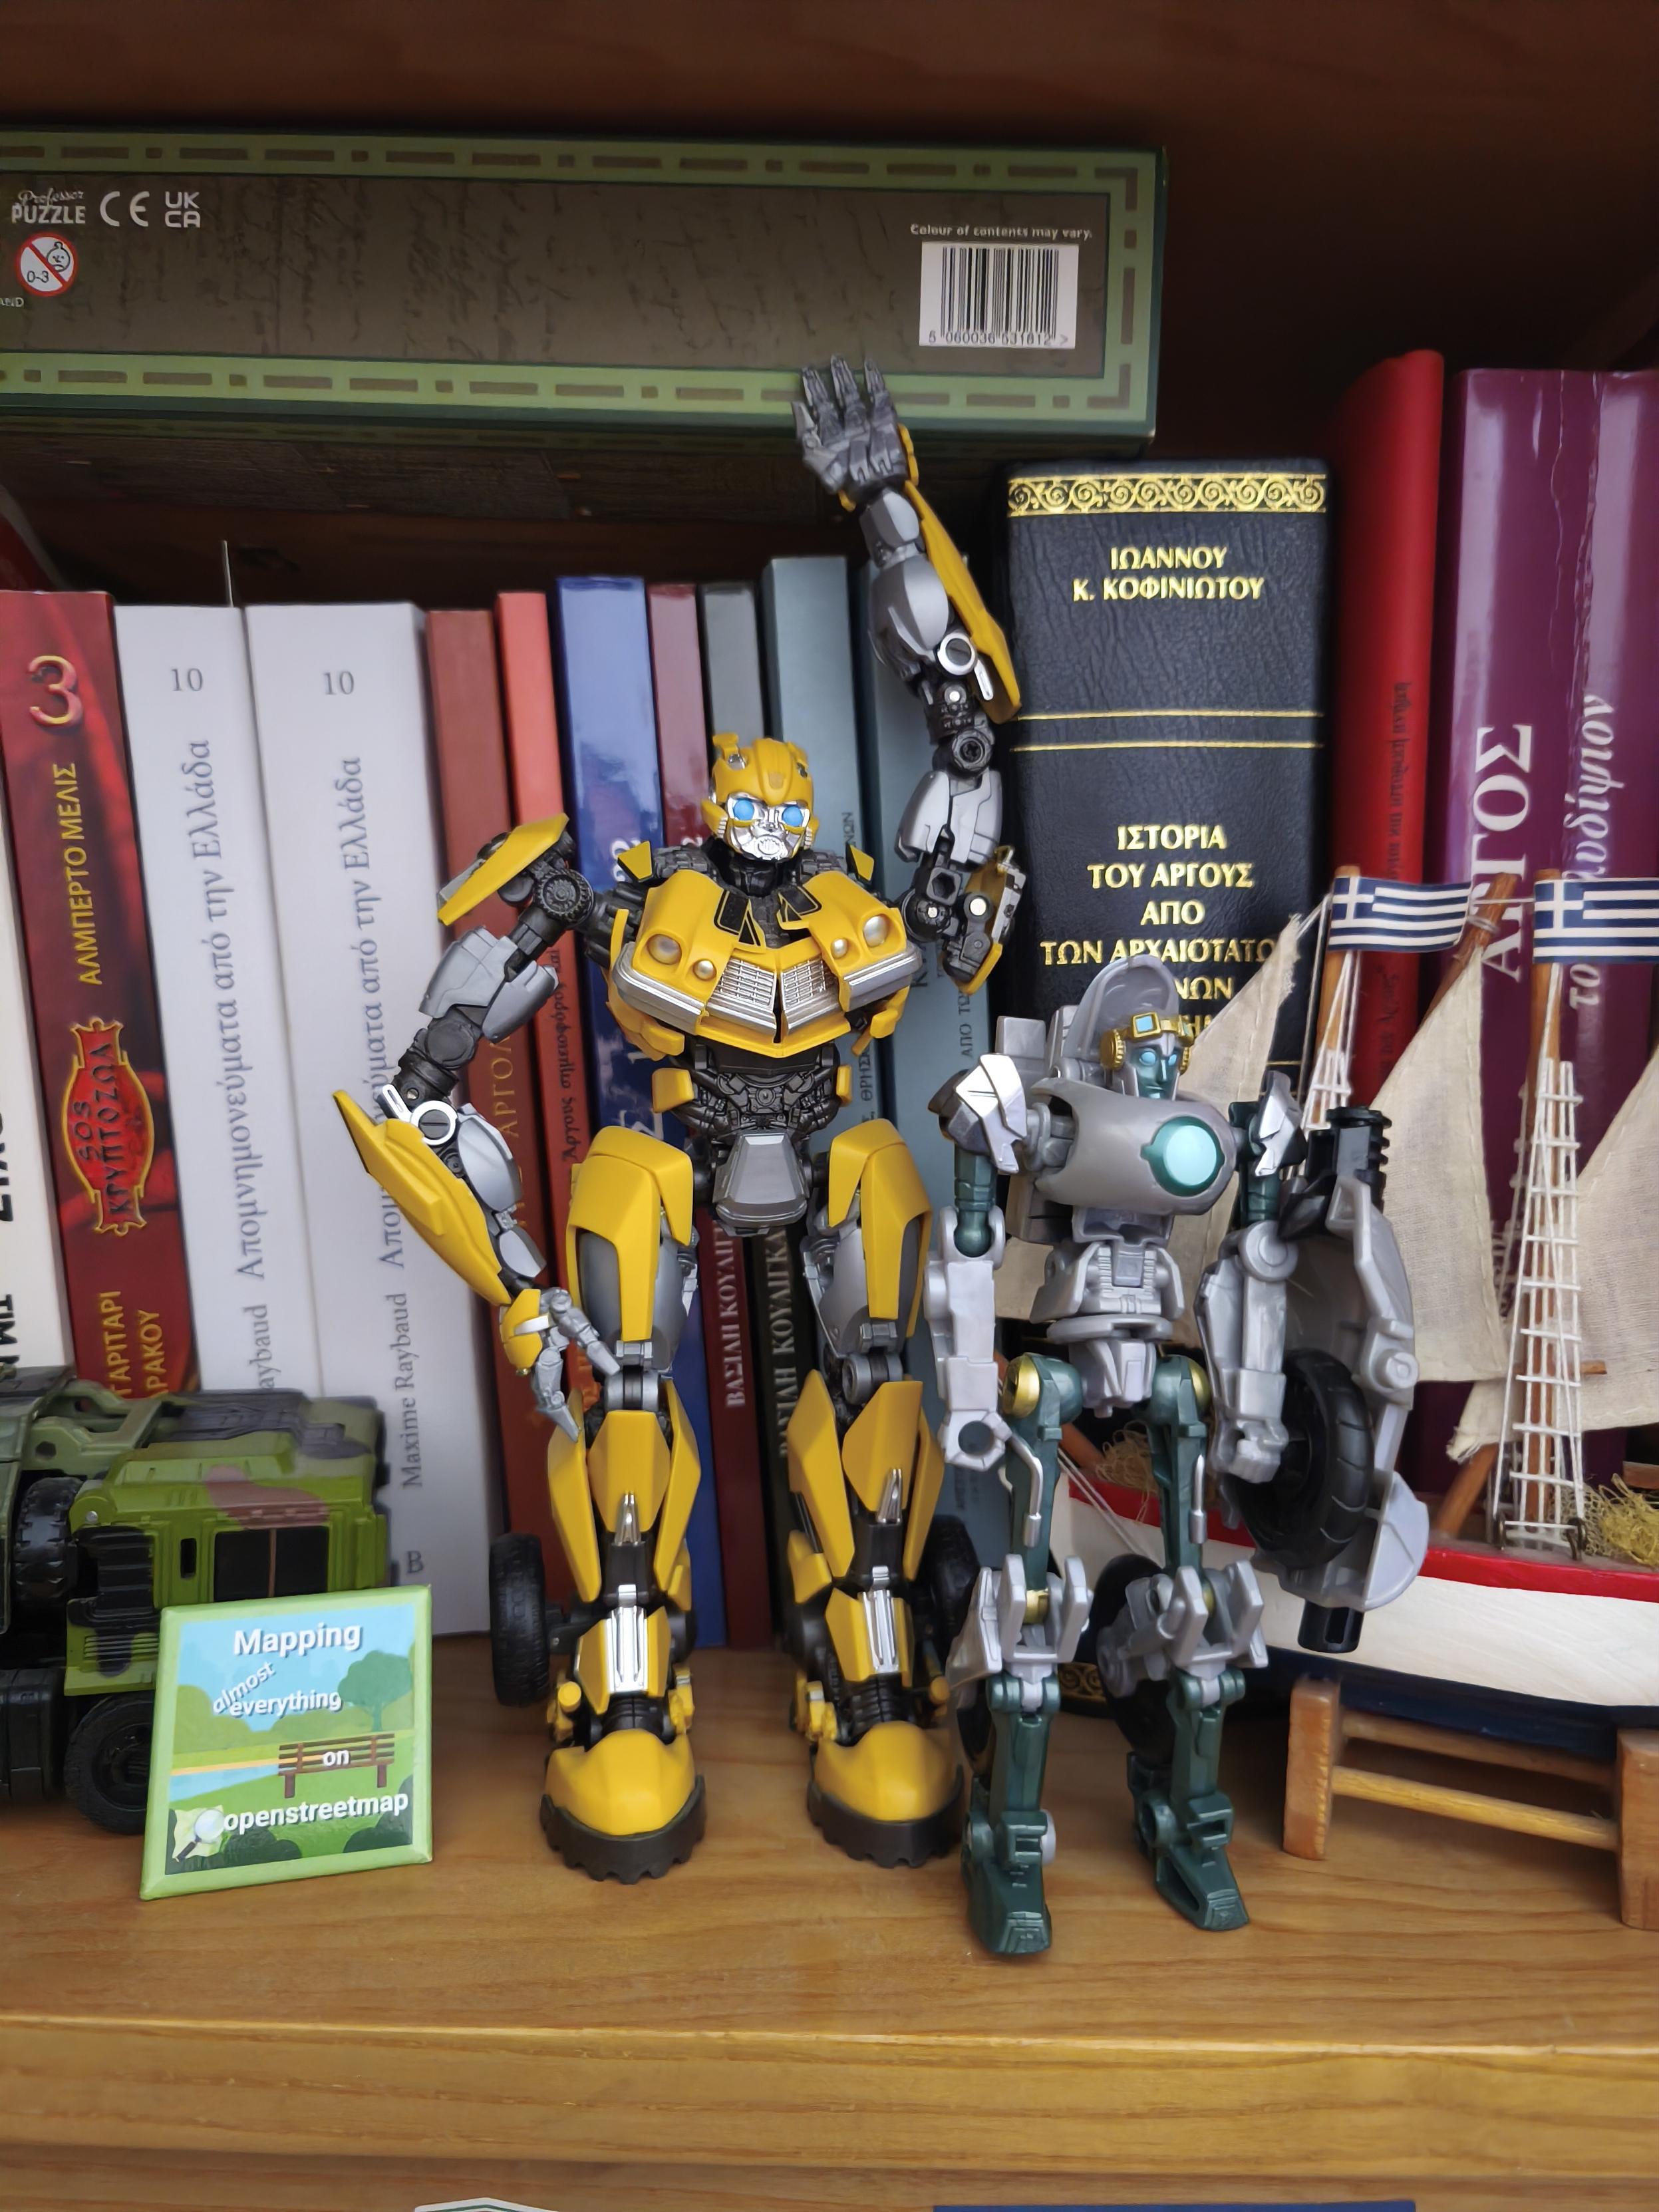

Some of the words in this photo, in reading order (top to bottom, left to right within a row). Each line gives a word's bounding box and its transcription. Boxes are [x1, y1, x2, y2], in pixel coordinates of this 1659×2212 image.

[11, 205, 86, 225] PUZZLE
[100, 191, 150, 228] CE
[165, 192, 200, 209] UK
[165, 210, 201, 228] CA
[910, 224, 953, 236] Colour
[957, 224, 969, 236] of
[973, 225, 1028, 237] contents
[1032, 228, 1058, 240] may
[1062, 229, 1093, 241] vary.
[27, 270, 49, 283] 0-3
[1110, 546, 1227, 570] ΙΩΑΝΝΟΥ
[1072, 577, 1095, 601] Κ.
[1103, 576, 1265, 601] ΚΟΦΙΝΙΩΤΟΥ
[27, 655, 83, 726] 3
[171, 668, 204, 691] 10
[323, 671, 355, 695] 10
[53, 762, 84, 840] ΜΕΛΙΣ
[181, 740, 222, 860] Ελλάδα
[1562, 695, 1625, 879] λυδίψιον
[335, 756, 370, 871] Ελλάδα
[1117, 824, 1227, 850] ΙΣΤΟΡΙΑ
[202, 869, 235, 922] την
[1087, 864, 1145, 889] ΤΟΥ
[1150, 862, 1255, 888] ΑΡΓΟΥΣ
[64, 847, 102, 986] ΑΛΜΠΕΡΤΟ
[353, 881, 382, 929] την
[1140, 899, 1206, 925] ΑΠΟ
[202, 932, 235, 990] από
[350, 939, 380, 994] από
[1040, 939, 1104, 965] ΤΩΝ
[1109, 938, 1276, 963] ΑΡΧΑΙΟΤΑΤΩ
[73, 1100, 102, 1162] SOS
[90, 1043, 132, 1217] ΚΡΥΠΤΟΖΩΑ
[216, 999, 267, 1279] Απομνημονεύματα
[243, 1303, 281, 1389] aybaud
[385, 1293, 420, 1392] Raybaud
[400, 1398, 422, 1489] Maxime
[233, 1622, 363, 1657] Mapping
[213, 1660, 276, 1714] almost
[229, 1690, 343, 1718] everything
[321, 1749, 351, 1768] on
[223, 1792, 409, 1835] openstreetmap
